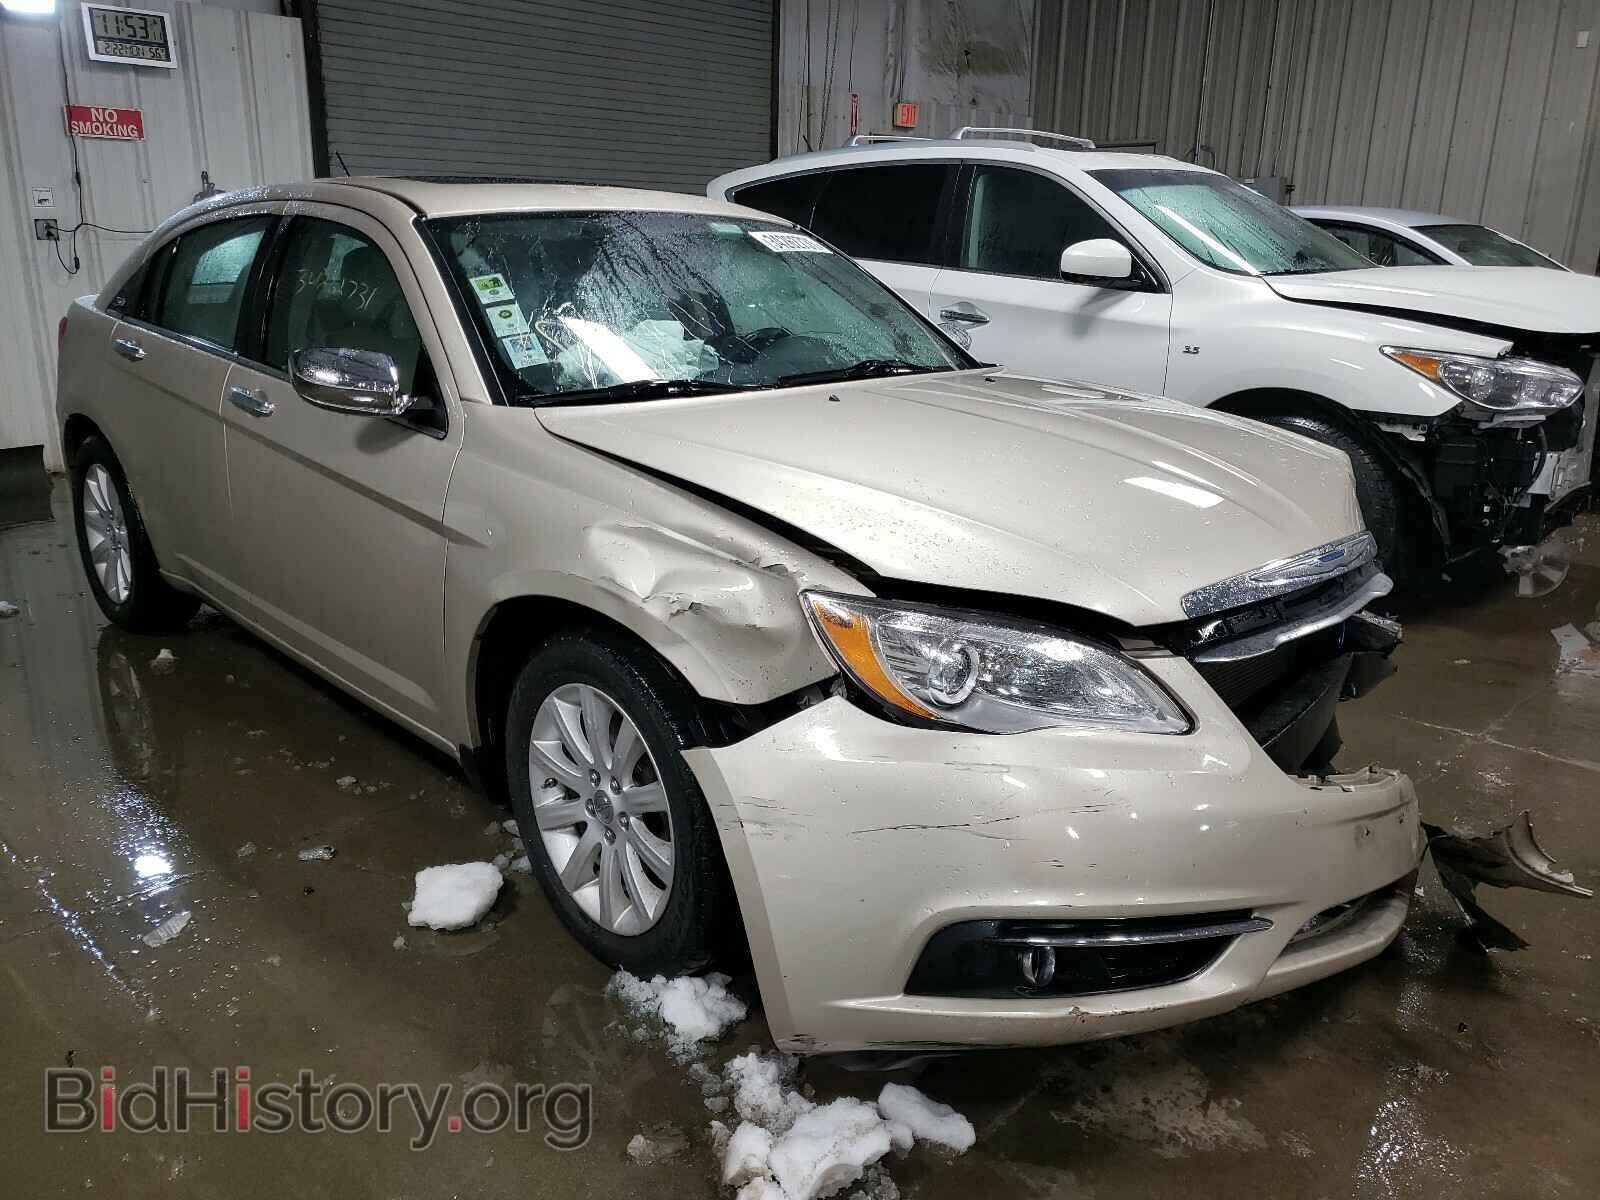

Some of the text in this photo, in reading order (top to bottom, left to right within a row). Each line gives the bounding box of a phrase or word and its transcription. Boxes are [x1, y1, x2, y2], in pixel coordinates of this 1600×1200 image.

[102, 14, 149, 39] 11:53
[91, 108, 117, 123] NO
[902, 104, 917, 124] EXIT
[71, 120, 138, 137] SMOKING
